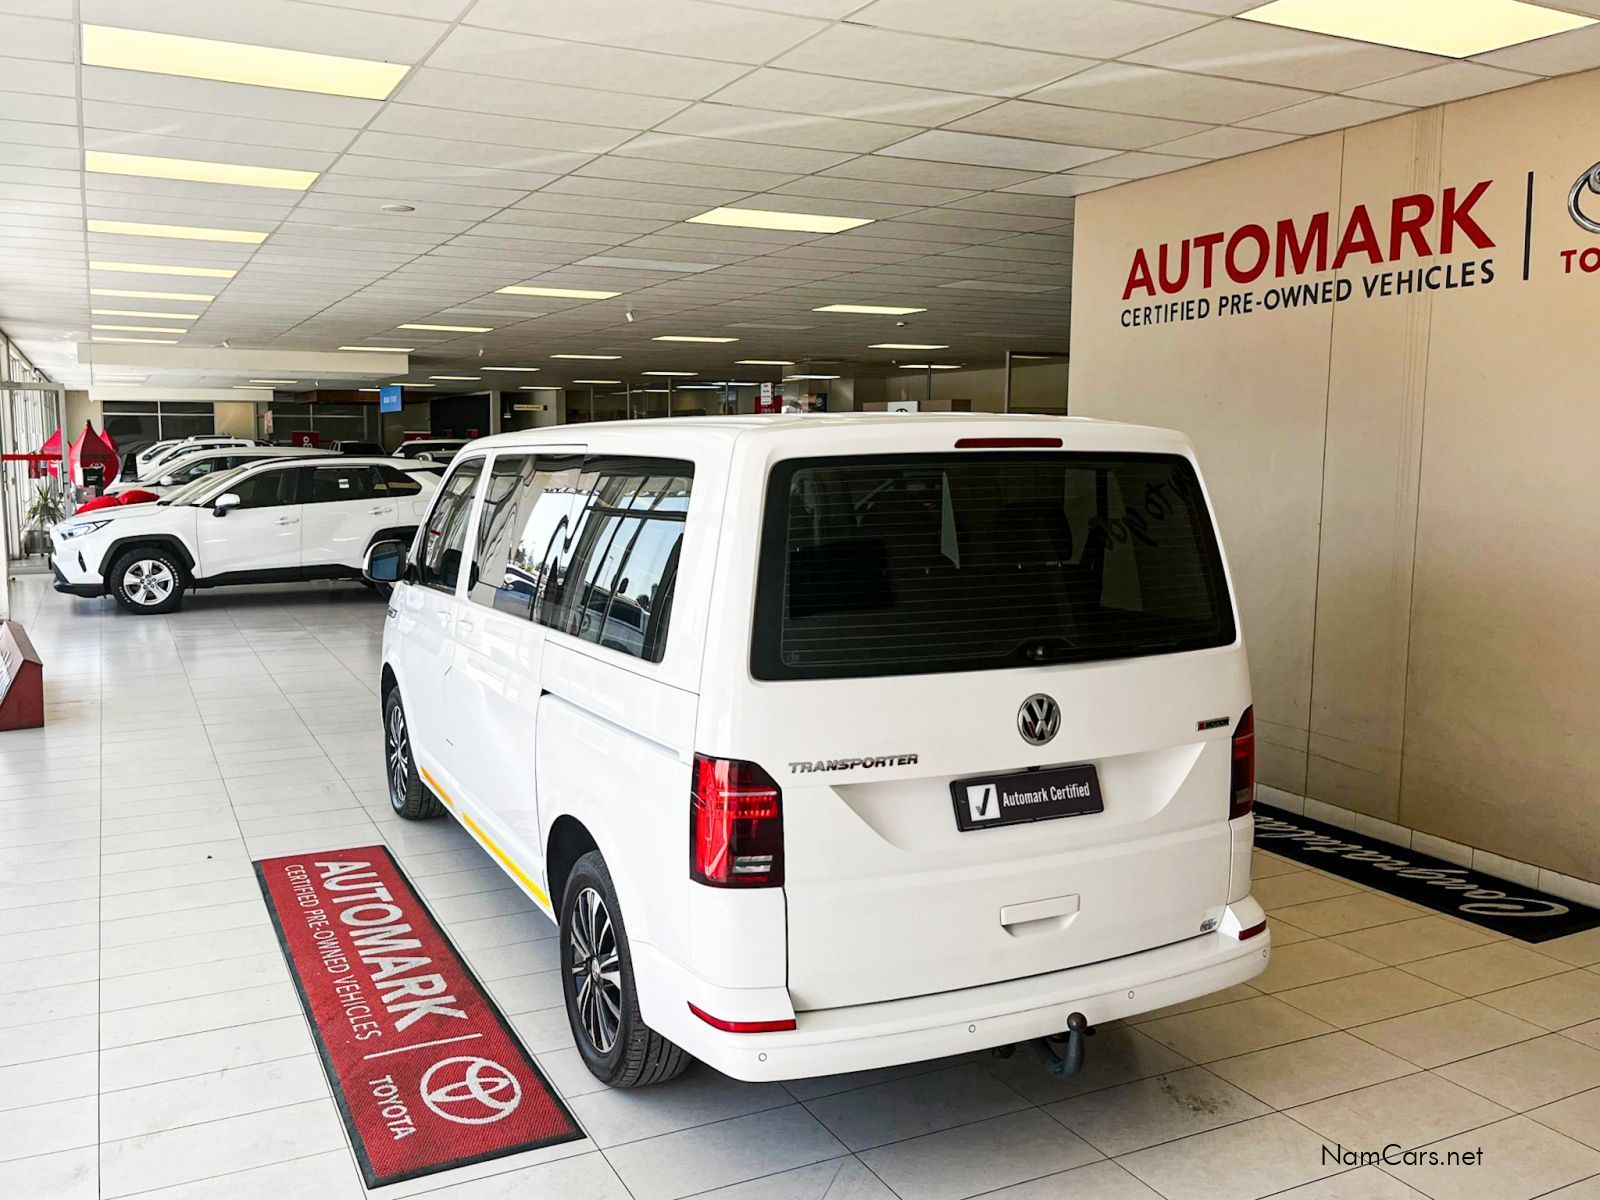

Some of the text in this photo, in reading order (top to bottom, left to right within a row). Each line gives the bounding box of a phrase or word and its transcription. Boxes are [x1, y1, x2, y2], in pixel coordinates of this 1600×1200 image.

[1121, 180, 1496, 300] AUTOMARK
[1120, 258, 1496, 328] CERTIFIED PRE-OWNED VEHICLES
[788, 753, 919, 774] TRANSPORTER
[1003, 782, 1090, 807] Automark Certified
[284, 864, 382, 1041] CERTIFIED PRE-OWNED VEHICLES
[314, 861, 468, 1032] AUTOMARK
[369, 1074, 416, 1140] TOYOTA
